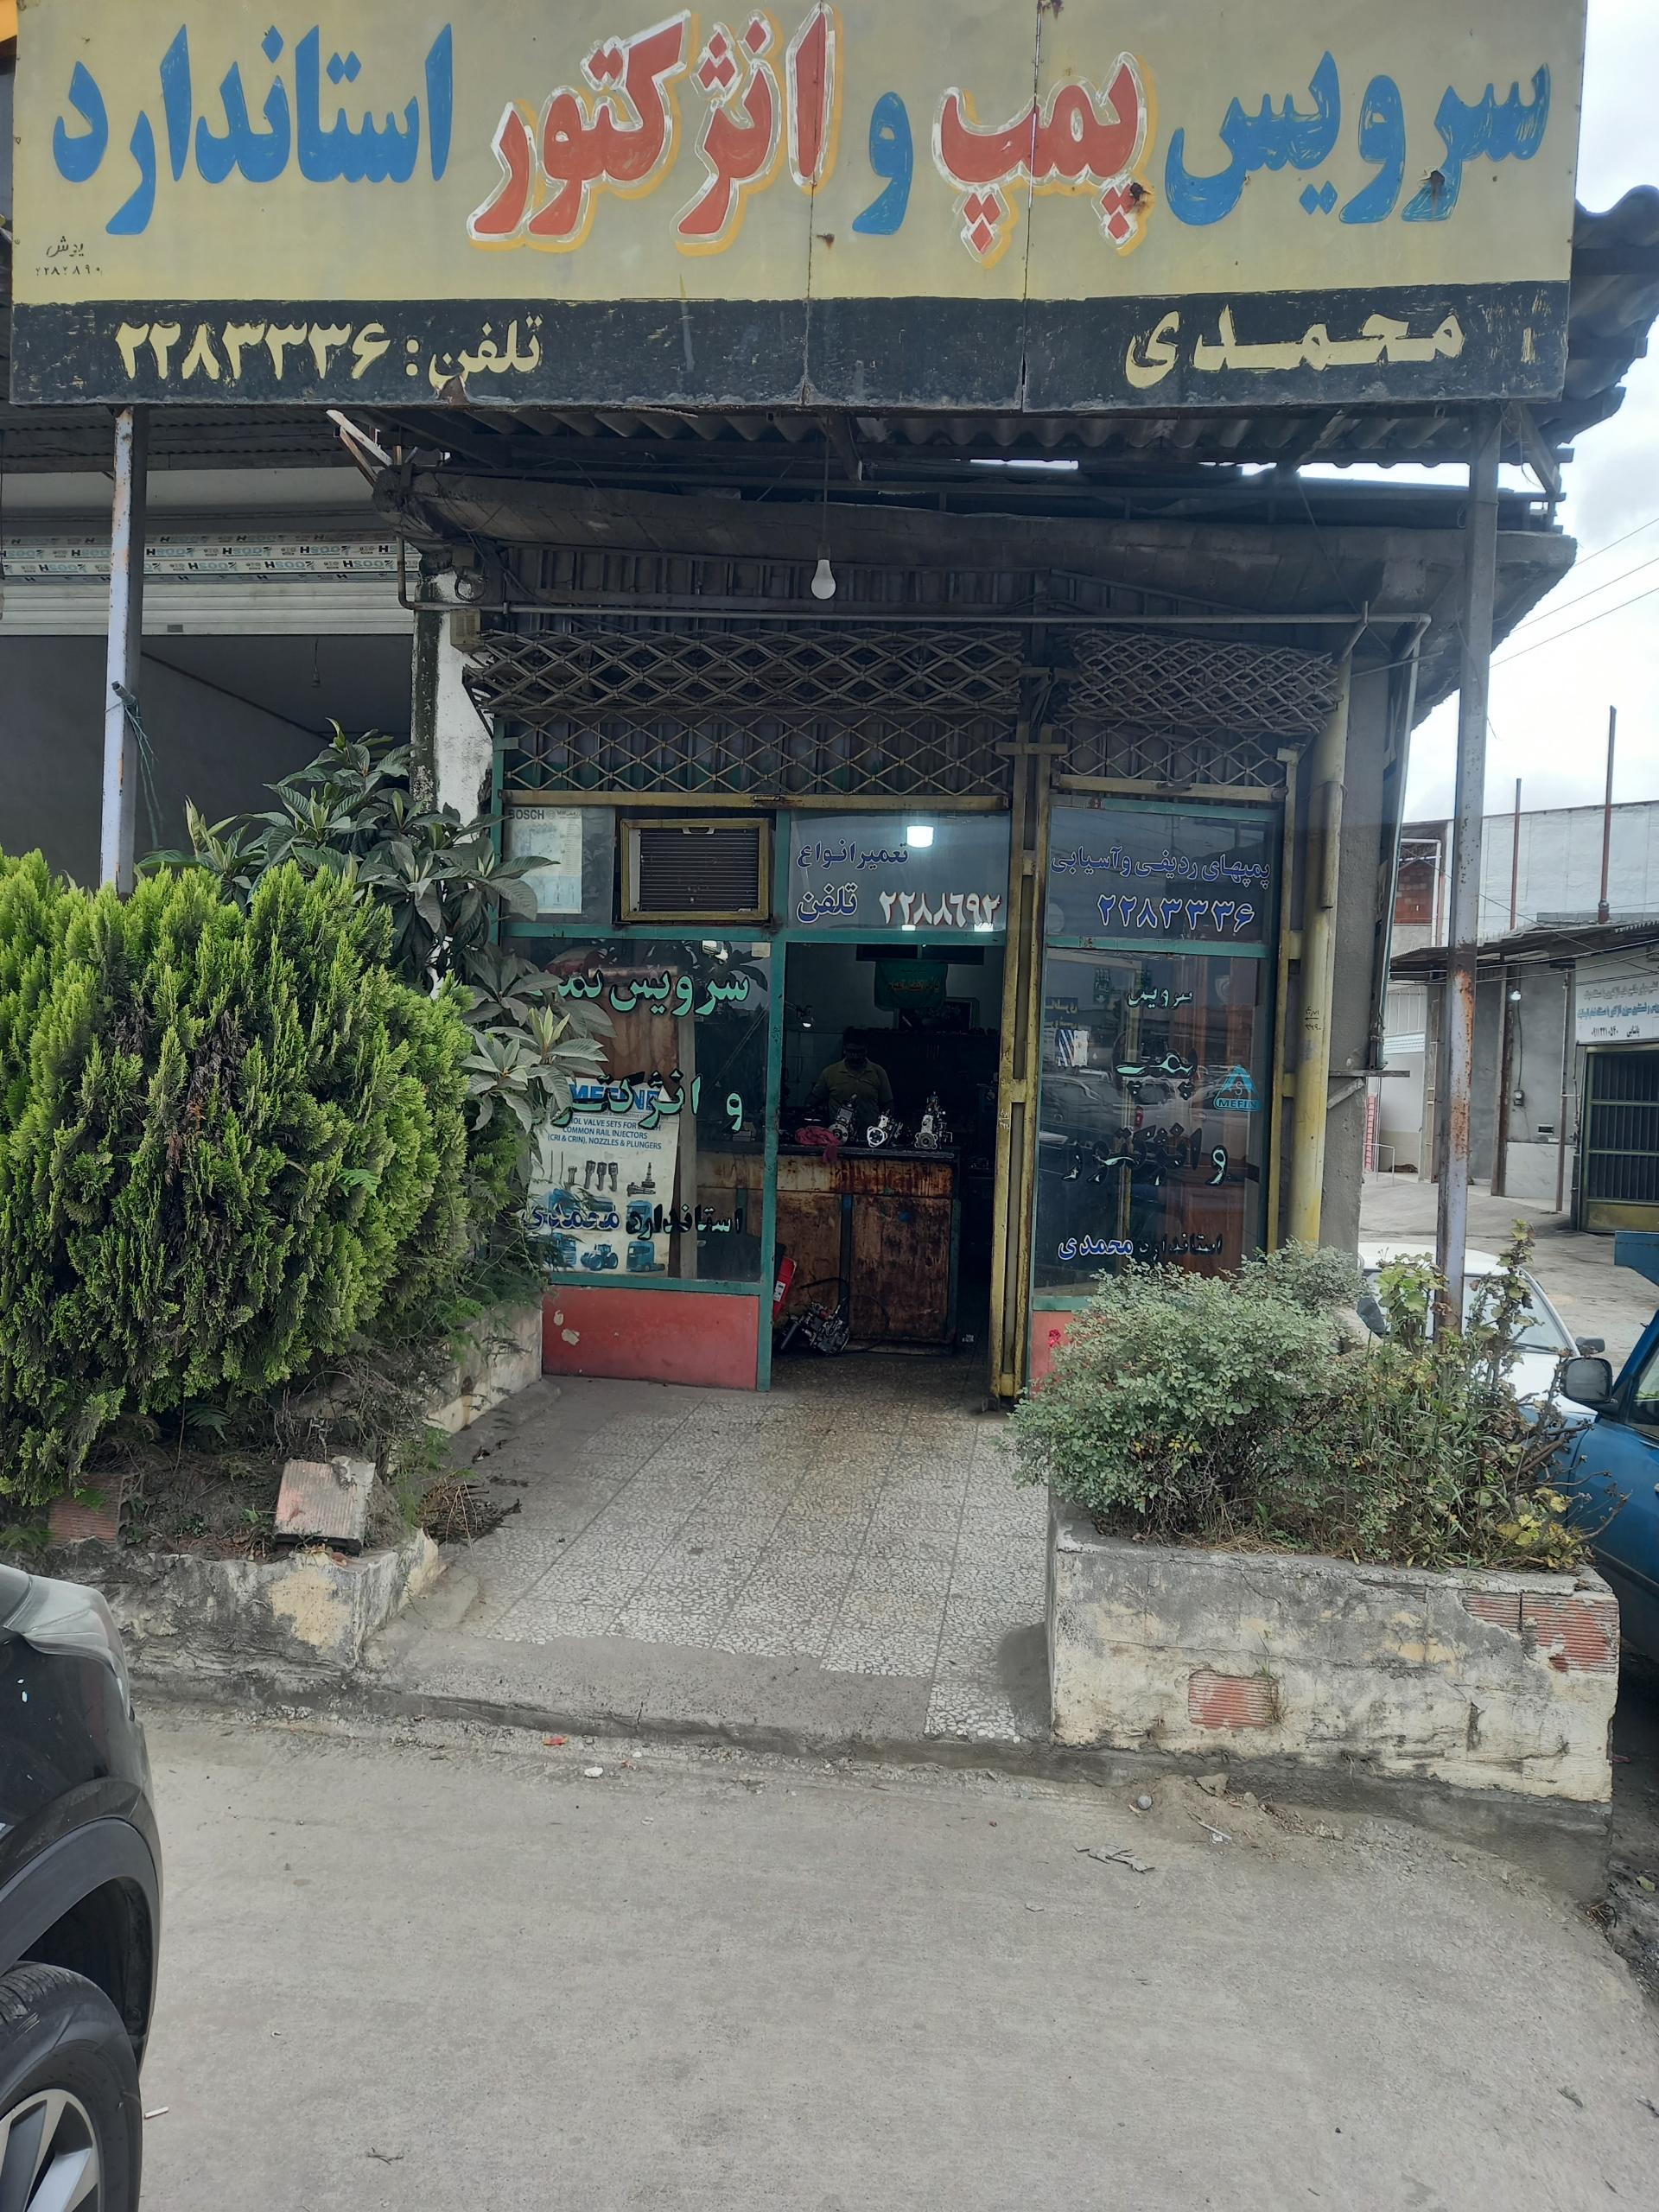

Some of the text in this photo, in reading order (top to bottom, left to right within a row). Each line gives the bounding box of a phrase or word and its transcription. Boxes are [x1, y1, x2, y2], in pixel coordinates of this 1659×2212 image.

[53, 2, 1550, 264] سرویس پمپ و انژکتور استاندارد
[115, 320, 391, 380] ۲۲۸۳۳۳۶
[1124, 304, 1466, 389] محمدی
[797, 839, 909, 870] تعمیر انواع
[1050, 846, 1270, 890] پمپهای ردیفی و آسیابی
[796, 881, 858, 924] تلفن
[1096, 893, 1255, 933] ۲۲۸۳۳۳۶
[608, 969, 750, 1016] سرویس
[1127, 988, 1193, 1009] سرویس
[584, 1117, 605, 1127] VALVE
[606, 1119, 621, 1128] SETS
[726, 1092, 742, 1131] و
[563, 1126, 595, 1135] COMMON
[612, 1130, 648, 1139] INJECTORS
[588, 1137, 619, 1147] NOZZLES
[627, 1141, 662, 1150] PLUNGERS
[1205, 1144, 1228, 1186] و
[518, 1204, 742, 1240] استاندارد محمدی
[1058, 1234, 1134, 1261] محمدی
